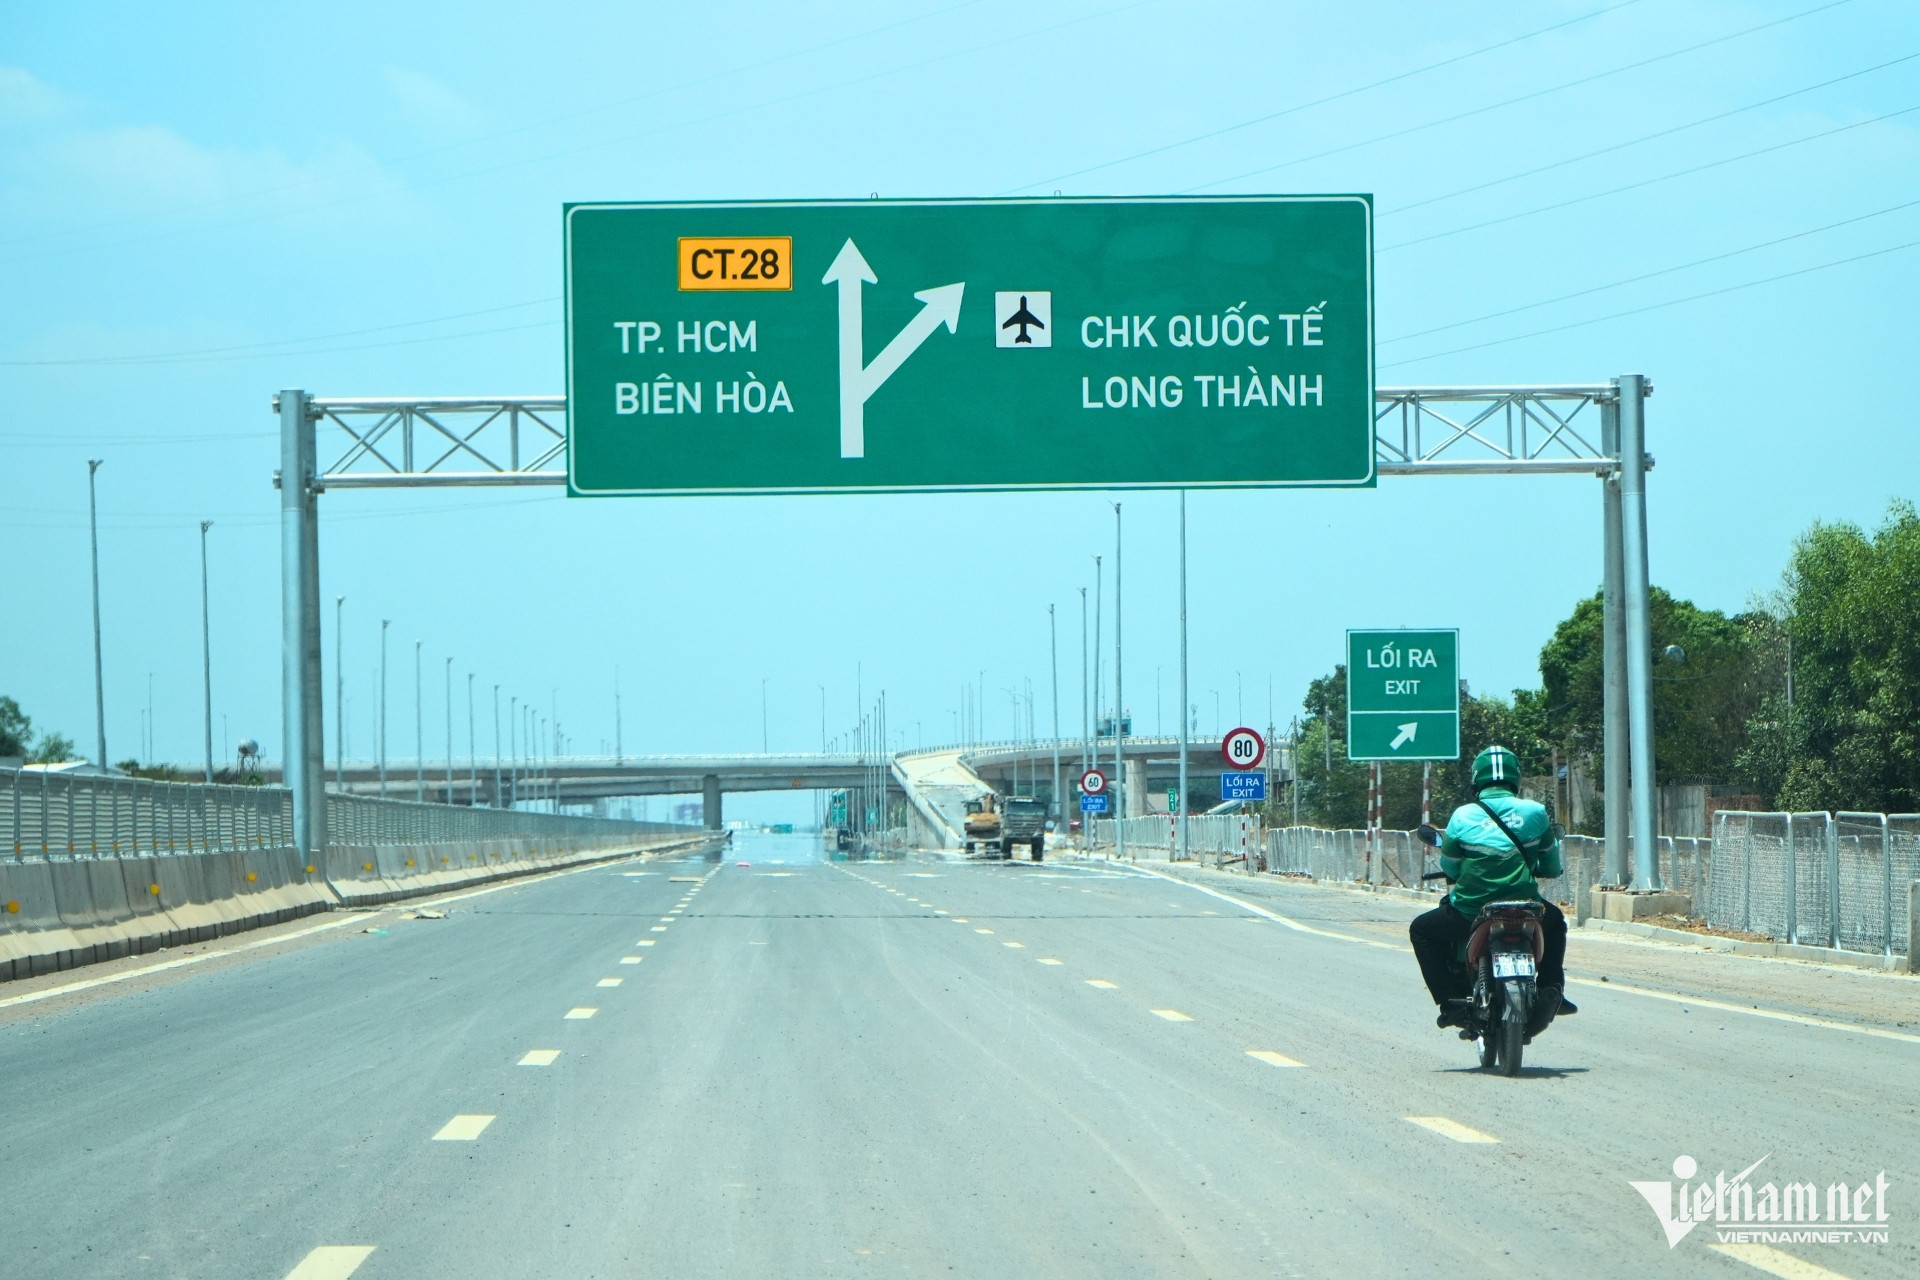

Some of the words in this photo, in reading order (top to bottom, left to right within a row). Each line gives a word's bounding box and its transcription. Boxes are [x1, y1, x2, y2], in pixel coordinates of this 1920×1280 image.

[691, 248, 780, 280] CT.28
[614, 322, 664, 353] TP.
[678, 320, 757, 353] HCM
[1081, 315, 1158, 348] CHK
[1168, 302, 1270, 347] QUỐC
[1279, 301, 1328, 346] TẾ
[616, 373, 702, 414] BIÊN
[716, 371, 794, 413] HÒA
[1082, 375, 1183, 409] LONG
[1194, 366, 1323, 407] THÀNH
[1367, 642, 1401, 668] LỐI
[1408, 648, 1437, 668] RA
[1385, 680, 1420, 695] EXIT
[1234, 739, 1253, 758] 80
[1088, 777, 1099, 788] 60
[1226, 775, 1243, 787] LỐI
[1245, 778, 1260, 787] RA
[1232, 788, 1254, 797] EXIT
